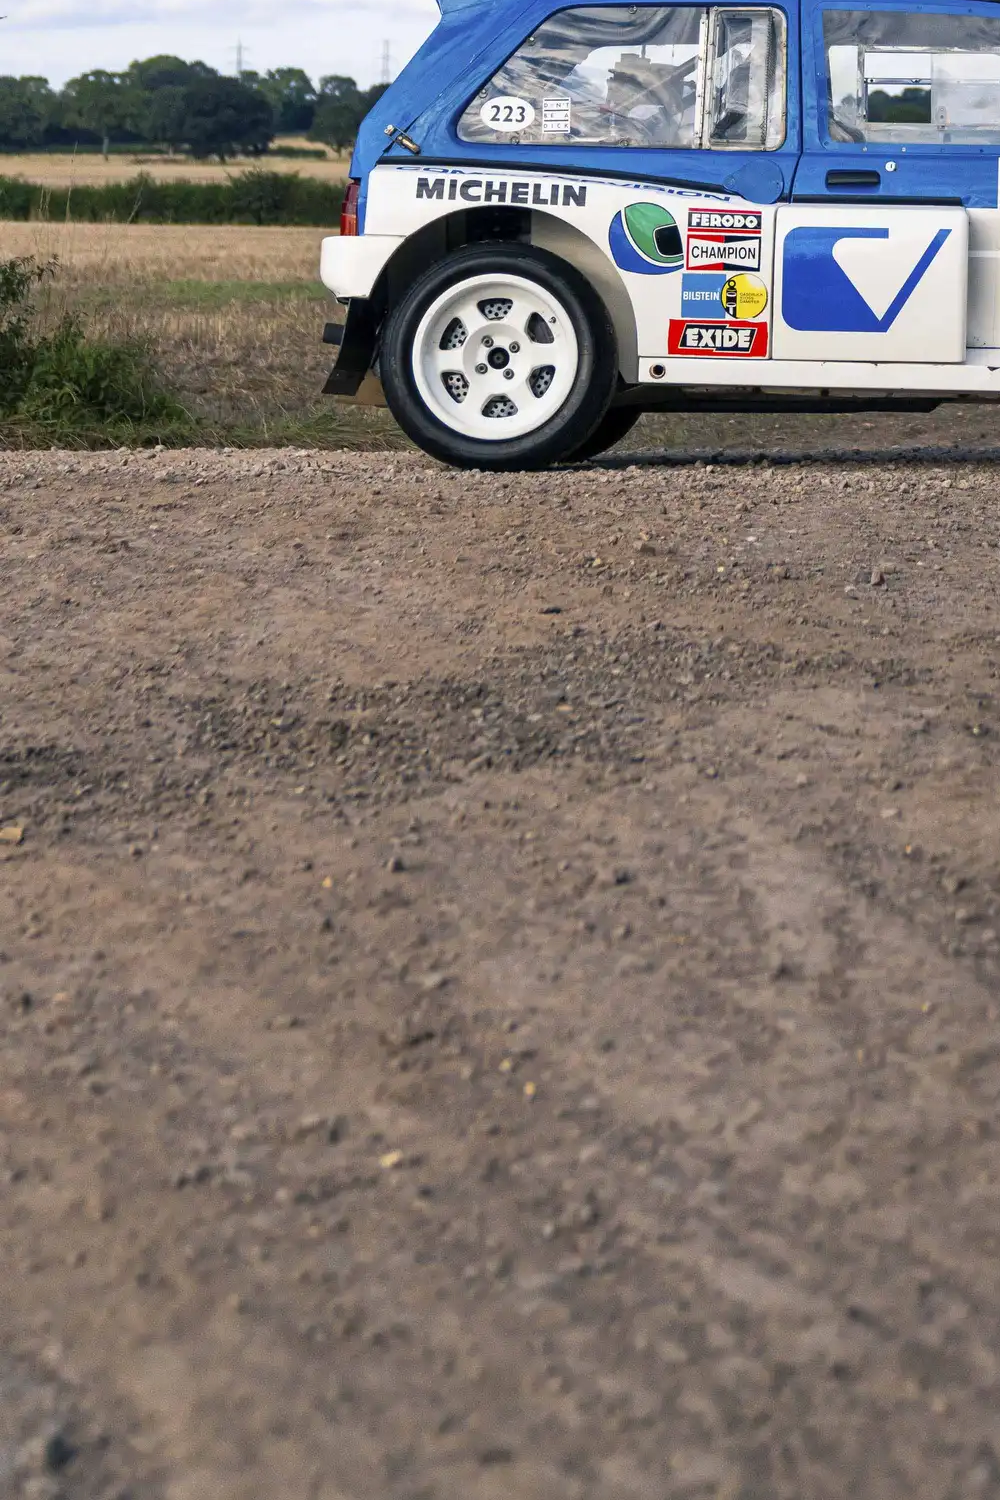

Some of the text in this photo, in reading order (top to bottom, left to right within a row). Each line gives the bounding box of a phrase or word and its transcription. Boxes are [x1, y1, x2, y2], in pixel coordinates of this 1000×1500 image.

[490, 105, 526, 122] 223
[416, 177, 587, 207] MICHELIN
[691, 213, 758, 229] FERODO
[691, 245, 756, 260] CHAMPION
[683, 291, 720, 301] BILSTEIN
[685, 327, 752, 348] EXIDE
